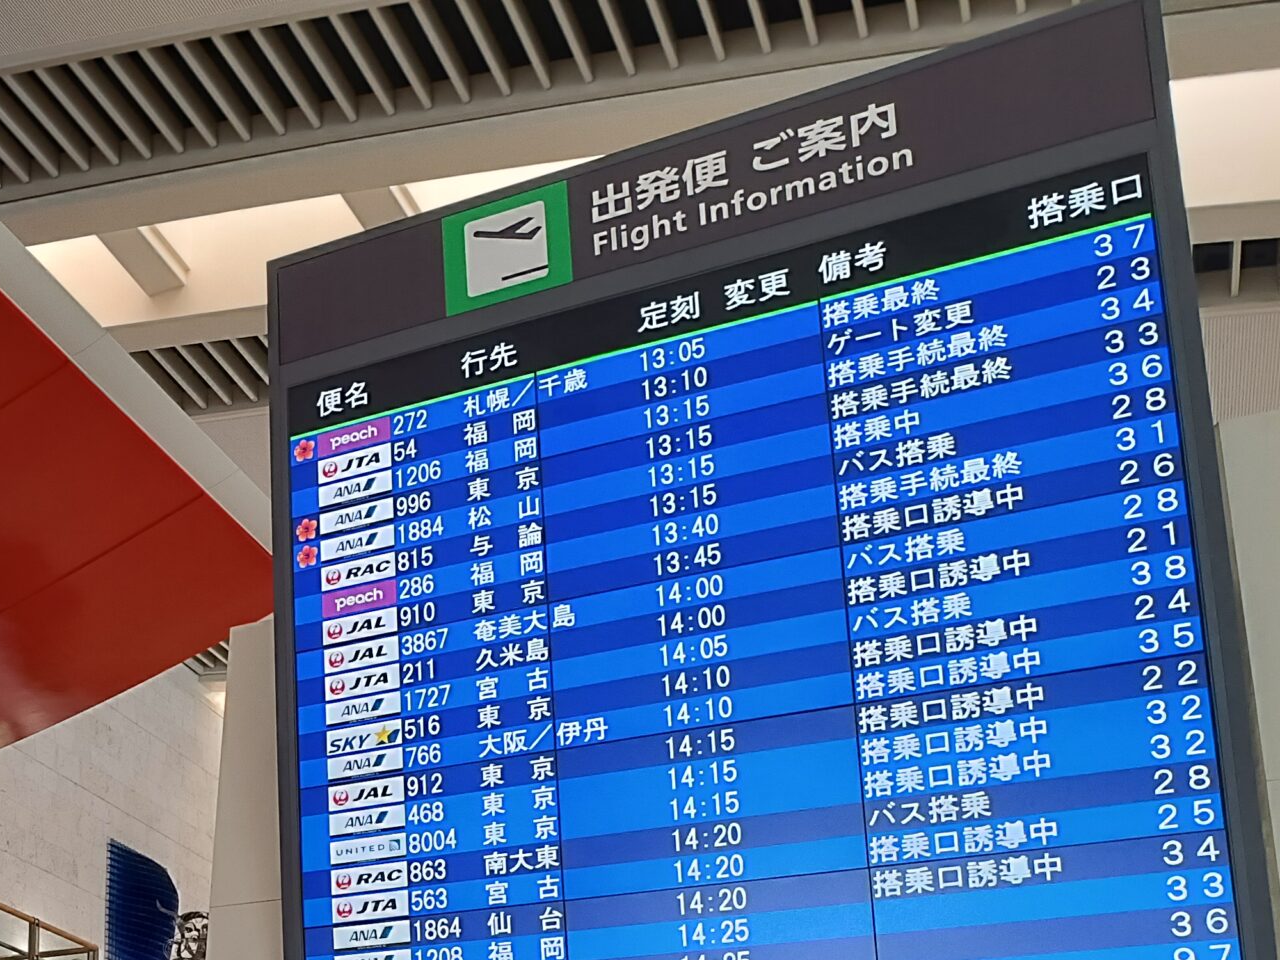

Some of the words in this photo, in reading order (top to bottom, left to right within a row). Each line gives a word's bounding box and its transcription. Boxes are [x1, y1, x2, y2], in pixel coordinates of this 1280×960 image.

[592, 151, 729, 223] 出発便
[752, 103, 898, 171] ご案内
[593, 210, 688, 256] Flight
[699, 149, 914, 226] Information
[317, 382, 369, 417] 便名
[461, 343, 517, 378] 行先
[637, 291, 701, 333] 定刻
[723, 268, 791, 311] 変更
[818, 241, 887, 284] 備考
[1028, 174, 1143, 229] 搭乗口
[330, 425, 377, 450] peach
[393, 409, 427, 435] 272
[640, 337, 705, 371] 13:05
[822, 278, 940, 328] 搭乗最終
[341, 452, 380, 472] JTA
[394, 438, 416, 461] 54
[642, 366, 707, 400] 13:10
[827, 300, 974, 355] ゲート変更
[396, 460, 441, 488] 1206
[644, 394, 709, 428] 13:15
[828, 325, 1008, 388] 搭乗手続最終
[396, 491, 430, 516] 996
[646, 424, 712, 458] 13:15
[831, 356, 1012, 419] 搭乗手続最終
[398, 515, 443, 543] 1884
[649, 453, 714, 487] 13:15
[834, 409, 919, 449] 搭乗中
[335, 587, 383, 611] peach
[399, 574, 434, 599] 286
[652, 513, 718, 545] 13:40
[839, 451, 1022, 510] 搭乗手続最終
[345, 560, 391, 579] RAC
[398, 546, 433, 571] 815
[650, 483, 716, 516] 13:15
[839, 432, 956, 475] バス搭乗
[346, 616, 385, 635] JAL
[400, 601, 435, 626] 910
[654, 542, 721, 575] 13:45
[348, 645, 387, 662] JAL
[401, 627, 448, 655] 3867
[473, 604, 575, 641] 奄美大島
[656, 574, 723, 606] 14:00
[847, 528, 965, 569] バス搭乗
[349, 672, 388, 690] JTA
[403, 658, 433, 684] 211
[476, 638, 548, 671] 久米島
[657, 604, 725, 636] 14:00
[404, 684, 450, 711] 1727
[660, 634, 727, 666] 14:05
[853, 592, 972, 631] バス搭乗
[329, 732, 370, 752] SKY
[404, 714, 440, 739] 516
[662, 665, 730, 696] 14:10
[405, 743, 441, 767] 766
[664, 696, 732, 726] 14:10
[352, 785, 392, 801] JAL
[407, 772, 442, 796] 912
[665, 728, 735, 759] 14:15
[408, 801, 443, 824] 468
[668, 759, 737, 789] 14:15
[335, 844, 385, 856] UNITED
[408, 828, 456, 853] 8004
[670, 790, 739, 820] 14:15
[356, 869, 402, 885] RAC
[410, 858, 446, 882] 863
[483, 845, 559, 875] 南大東
[672, 822, 741, 851] 14:20
[869, 791, 991, 826] バス搭乗
[356, 898, 397, 914] JTA
[411, 887, 447, 911] 563
[674, 854, 744, 882] 14:20
[414, 917, 461, 941] 1864
[677, 886, 746, 915] 14:20
[679, 918, 749, 946] 14:25
